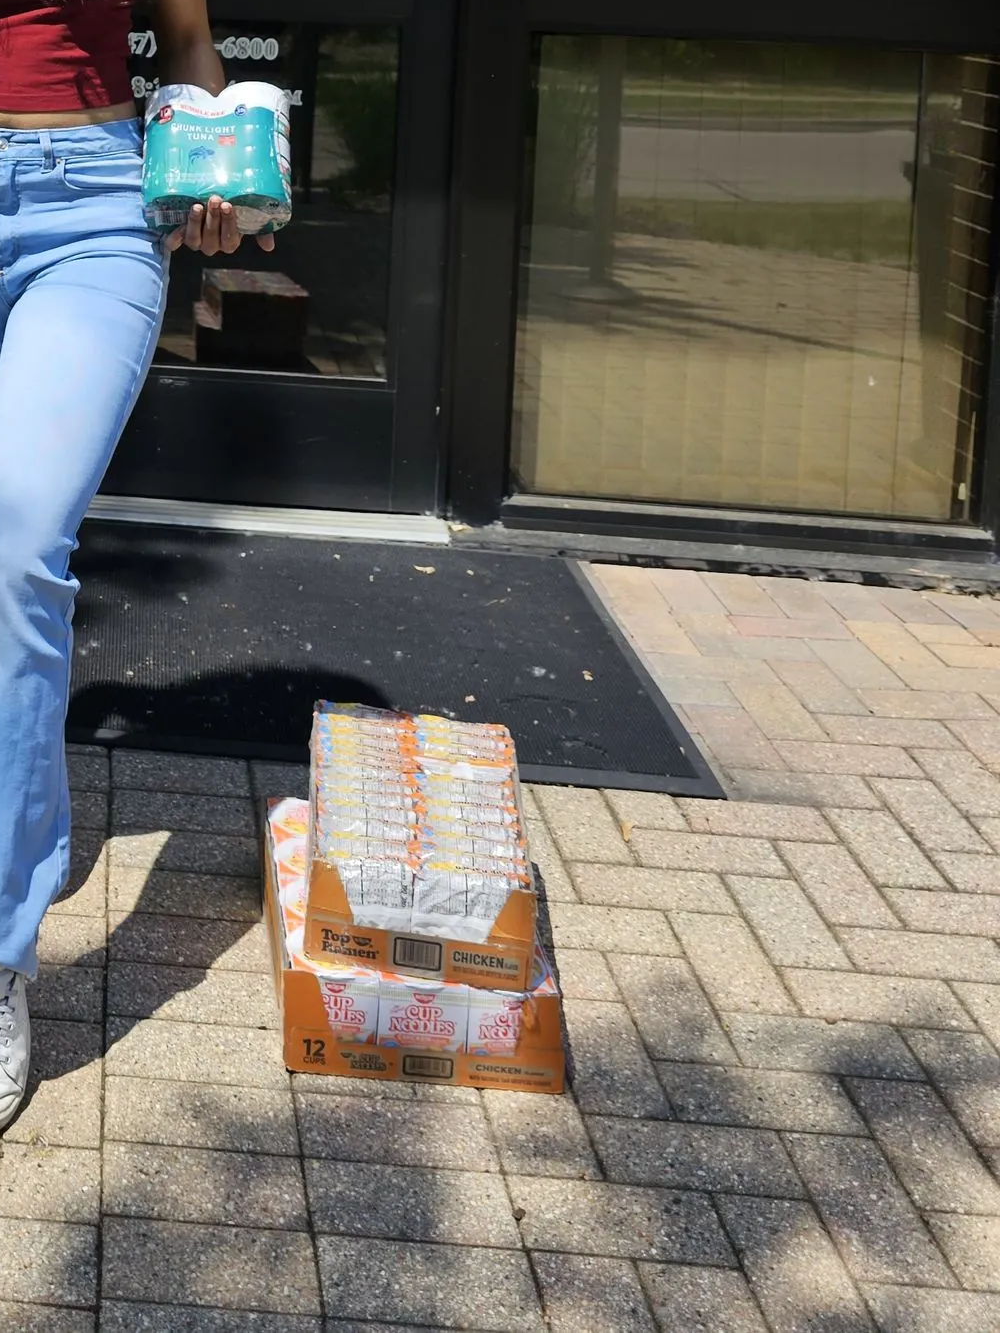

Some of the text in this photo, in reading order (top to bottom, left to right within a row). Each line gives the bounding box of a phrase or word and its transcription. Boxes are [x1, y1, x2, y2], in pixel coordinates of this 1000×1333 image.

[171, 123, 236, 134] CHUNK LIGHT
[188, 133, 214, 141] TUNA
[321, 928, 350, 944] Top
[321, 941, 377, 960] Ramen
[453, 951, 504, 969] CHICKEN
[327, 1007, 366, 1026] DLES
[405, 1005, 443, 1021] CUP
[388, 1017, 456, 1036] NOODLES
[302, 1038, 326, 1057] 12
[303, 1057, 326, 1065] CUPS
[475, 1064, 522, 1074] CHICKEN
